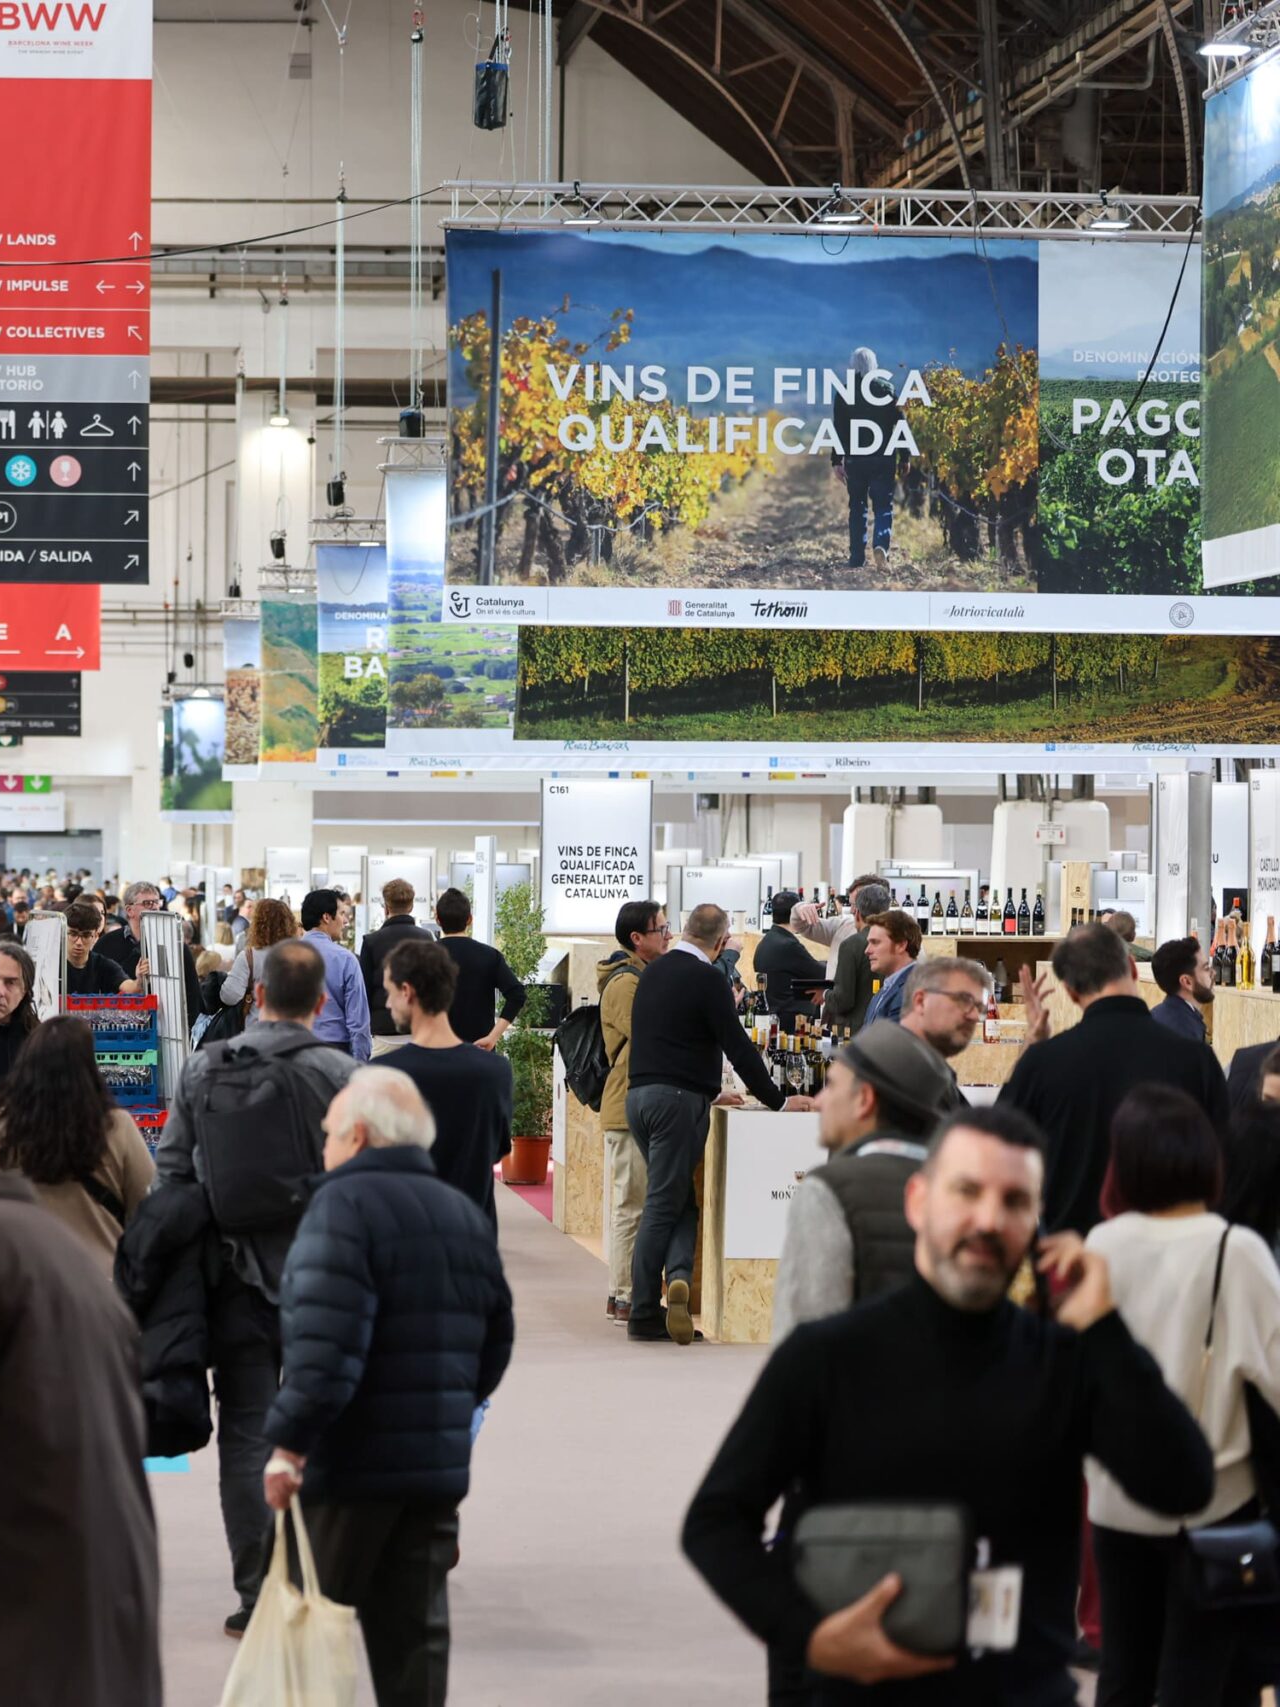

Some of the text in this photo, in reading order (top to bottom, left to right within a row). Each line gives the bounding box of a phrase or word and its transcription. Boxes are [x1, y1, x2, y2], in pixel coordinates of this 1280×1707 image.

[7, 234, 56, 245] LANDS
[6, 280, 69, 291] IMPULSE
[6, 327, 105, 338] COLLECTIVES
[6, 365, 36, 376] HUB
[546, 364, 932, 406] VINS DE FINCA
[557, 414, 920, 455] QUALIFICADA
[39, 551, 93, 562] SALIDA
[476, 597, 524, 608] Catalunya
[685, 601, 728, 609] Generalitat
[685, 609, 735, 619] de Catalunya
[55, 624, 72, 640] A
[835, 757, 871, 767] Ribeiro
[549, 786, 569, 794] C161
[558, 846, 638, 857] VINS DE FINCA
[560, 860, 635, 870] QUALIFICADA
[551, 874, 644, 885] GENERALITAT DE
[565, 888, 630, 898] CATALUNYA
